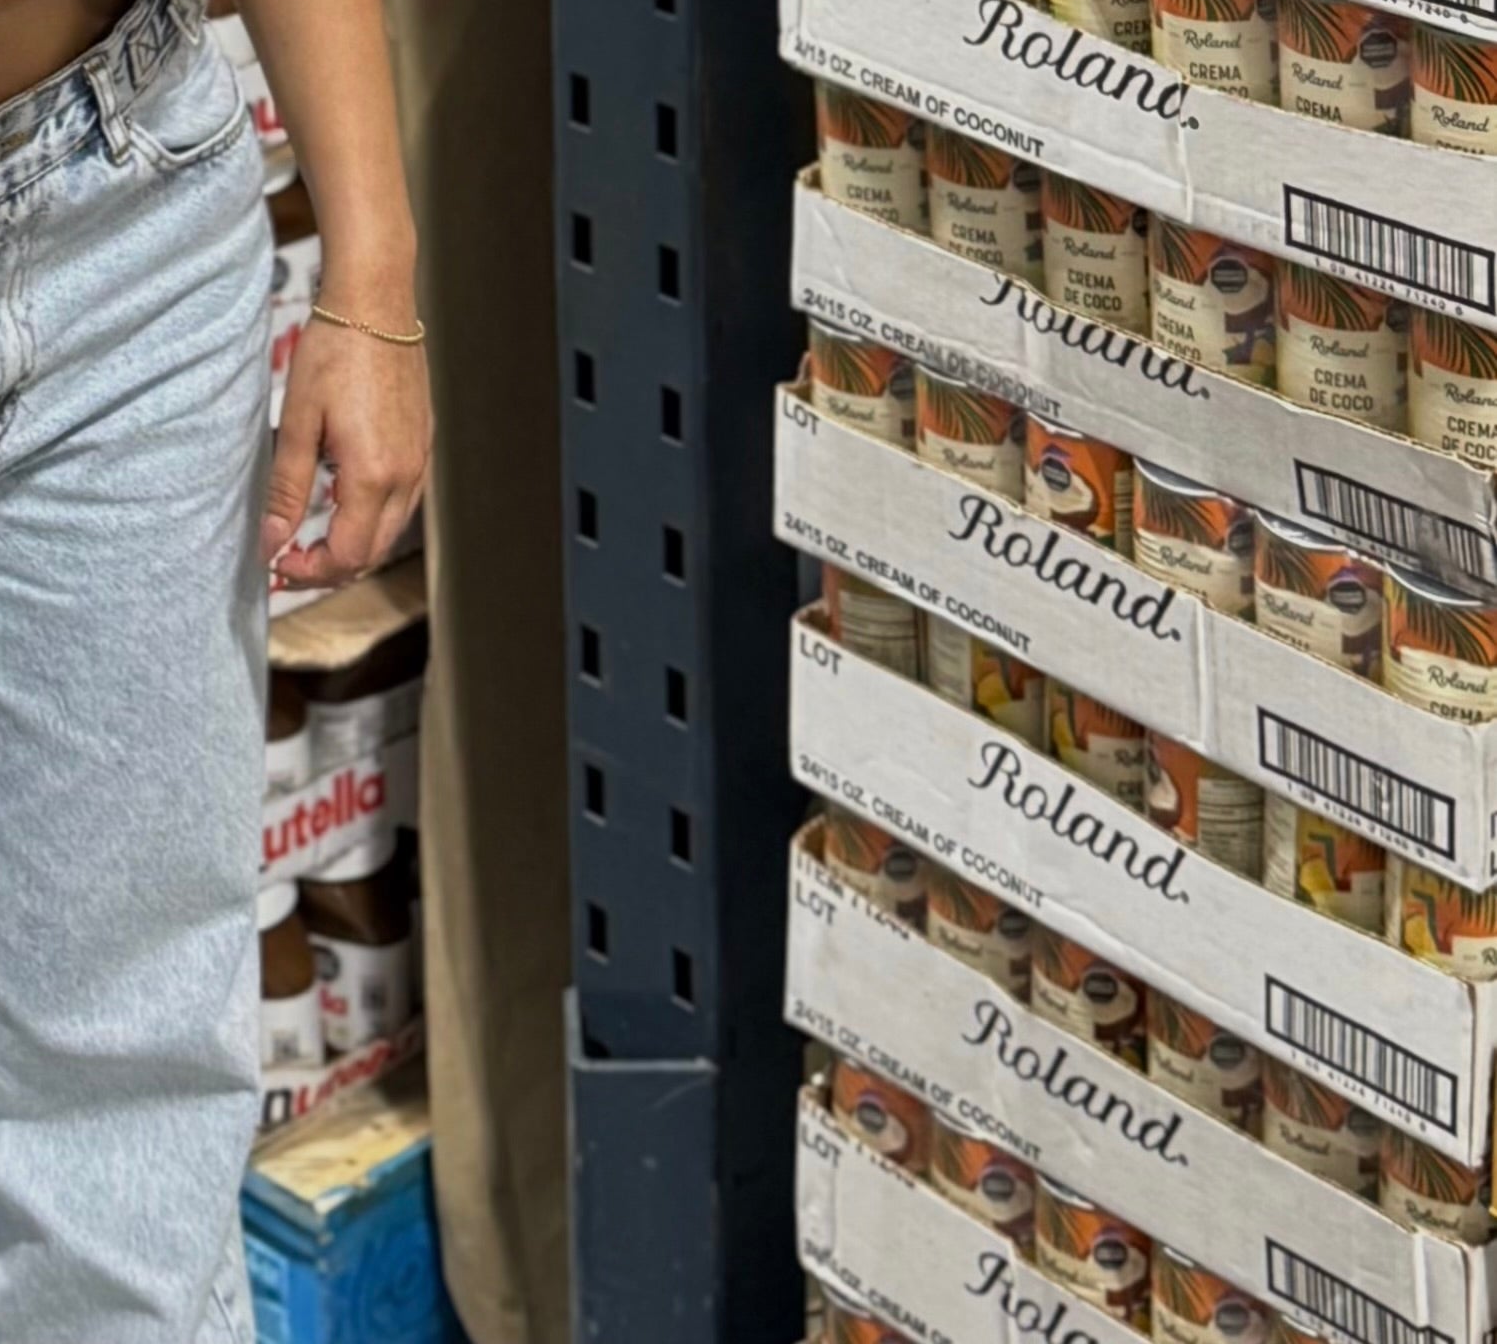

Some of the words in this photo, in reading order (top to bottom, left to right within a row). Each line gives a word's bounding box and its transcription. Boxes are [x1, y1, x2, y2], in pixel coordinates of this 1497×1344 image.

[1113, 21, 1151, 38] CREM
[1184, 29, 1242, 50] Roland
[1189, 61, 1242, 82] CREMA
[1291, 61, 1343, 91] Roland
[829, 56, 857, 80] OZ.
[860, 67, 922, 110] CREAM
[926, 94, 950, 118] OF
[953, 106, 1046, 159] COCONUT
[1295, 96, 1343, 123] CREMA
[1431, 104, 1490, 133] Roland
[846, 183, 893, 203] CREMA
[947, 191, 999, 216] Roland
[951, 223, 998, 246] CREMA
[1063, 236, 1117, 261] Roland
[1067, 268, 1116, 292] CREMA
[1064, 285, 1081, 304] DE
[1083, 291, 1123, 313] COCO
[803, 287, 847, 322] 24/15
[849, 311, 877, 337] OZ.
[880, 322, 945, 367] CREAM
[1309, 334, 1369, 359] Roland
[1313, 367, 1367, 390] CREMA
[1309, 386, 1329, 405] DE
[1331, 393, 1374, 412] COCO
[783, 396, 821, 437] LOT
[942, 447, 996, 472] Roland
[948, 494, 1180, 642] Roland
[1158, 544, 1212, 576] Roland
[783, 511, 823, 548] 24/15
[825, 534, 852, 561] OZ.
[855, 549, 916, 595] CREAM
[918, 582, 943, 606] OF
[945, 595, 1031, 654] COCONUT
[799, 633, 843, 676] LOT
[1426, 665, 1489, 696] Roland
[263, 767, 386, 864] utella
[967, 740, 1191, 905] Roland
[842, 779, 869, 809] OZ.
[872, 795, 930, 845] CREAM
[933, 831, 959, 858] OF
[962, 846, 1044, 910] COCONUT
[794, 880, 838, 925] LOT
[961, 998, 1191, 1166] Roland
[868, 1044, 926, 1094] CREAM
[929, 1081, 955, 1106] OF
[957, 1096, 1042, 1162] COCONUT
[801, 1127, 842, 1167] LOT
